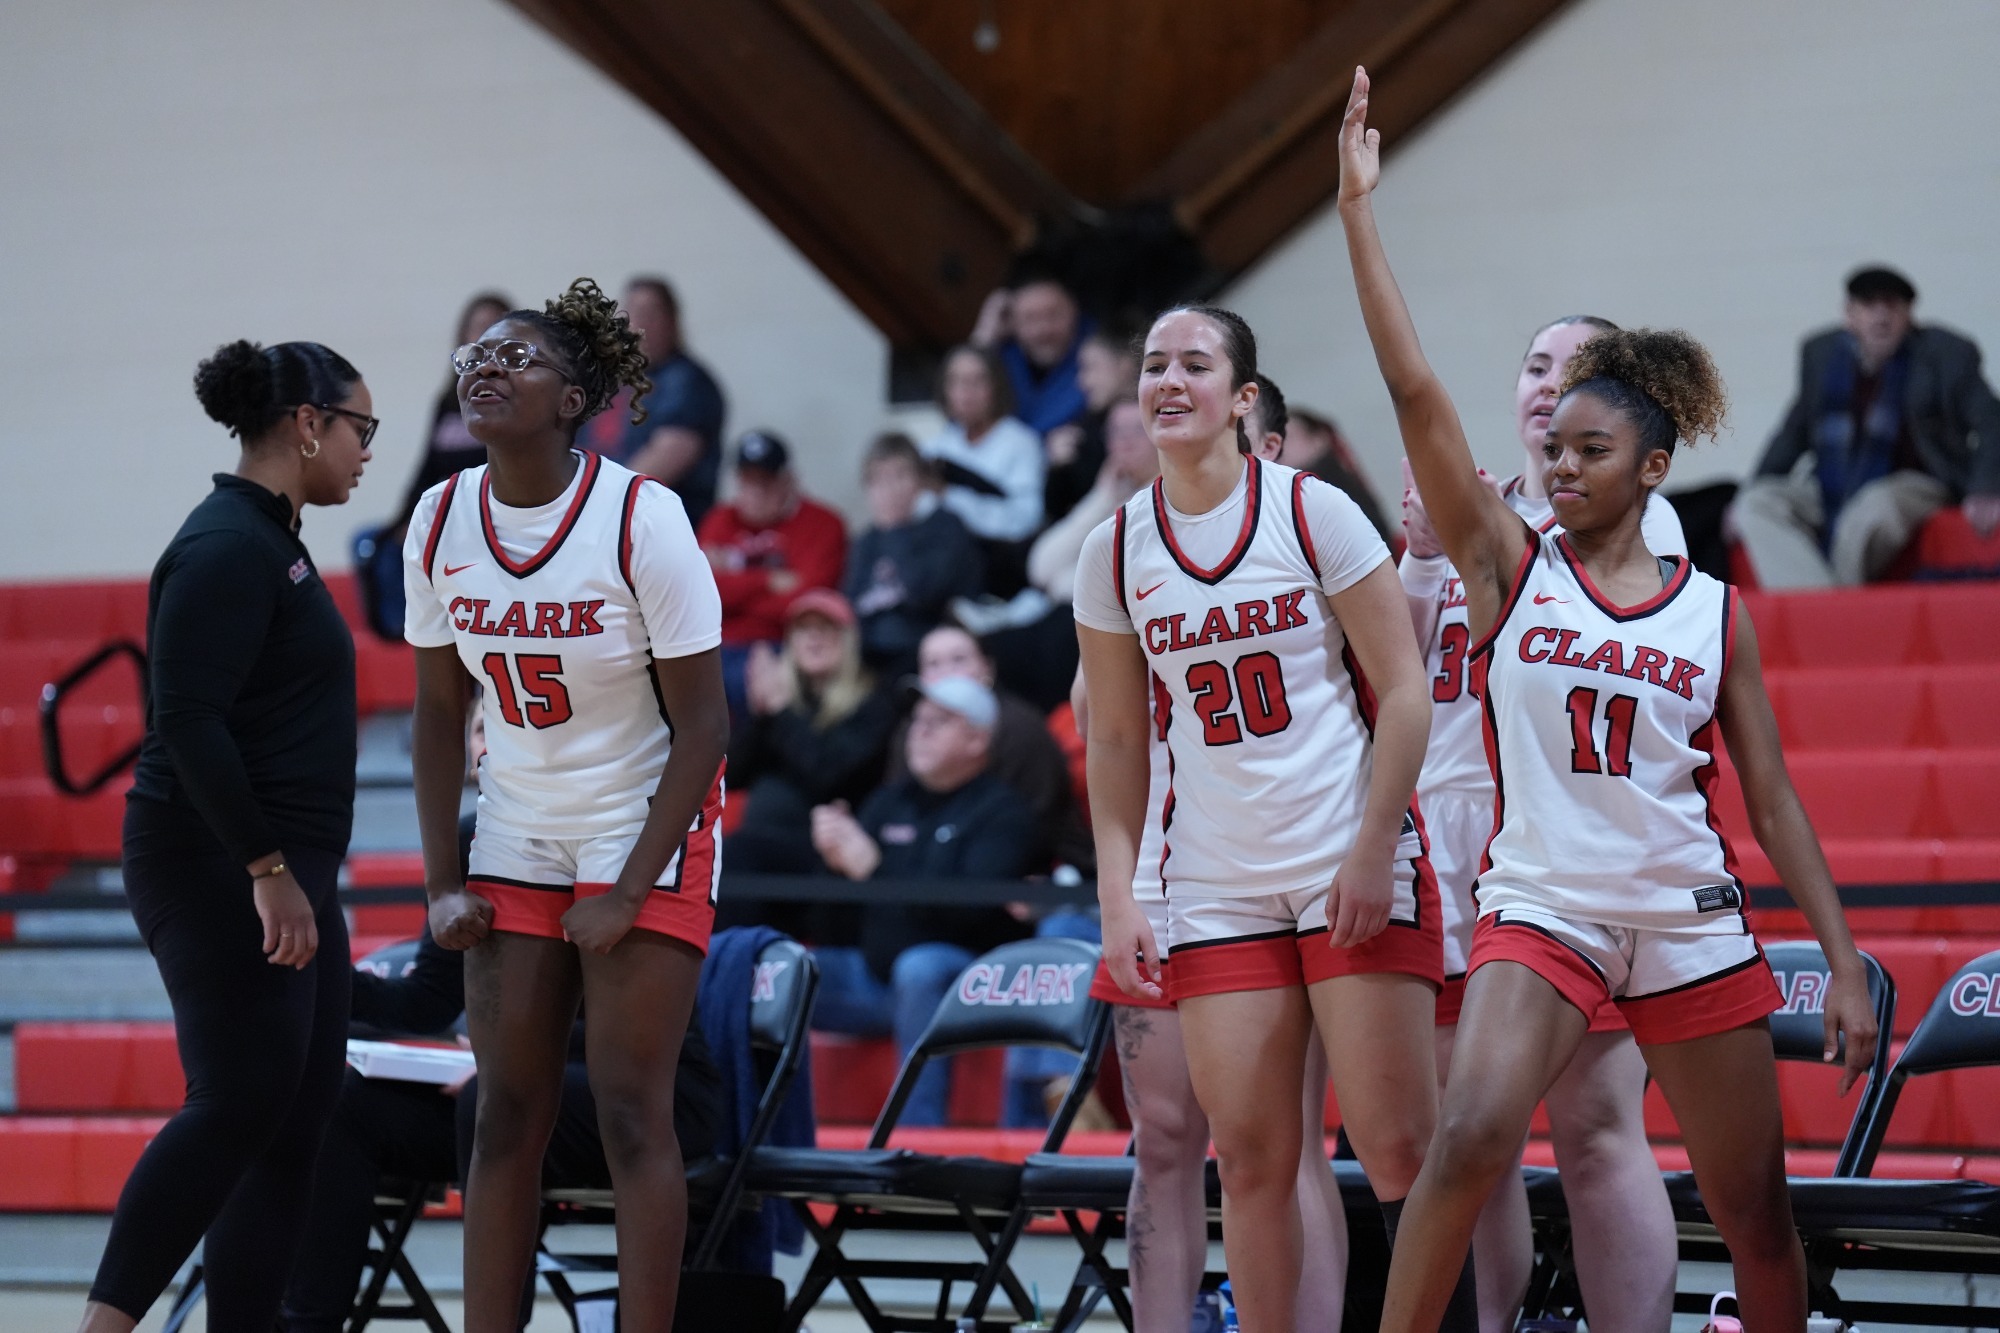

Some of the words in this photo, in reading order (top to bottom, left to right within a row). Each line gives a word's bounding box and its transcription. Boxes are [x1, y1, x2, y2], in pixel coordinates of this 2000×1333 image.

[449, 596, 605, 638] CLARK
[1145, 589, 1308, 655] CLARK
[482, 652, 573, 730] 15
[1185, 650, 1292, 746] 20
[1518, 626, 1705, 701] CLARK
[1566, 685, 1639, 779] 11
[958, 964, 1089, 1005] CLARK
